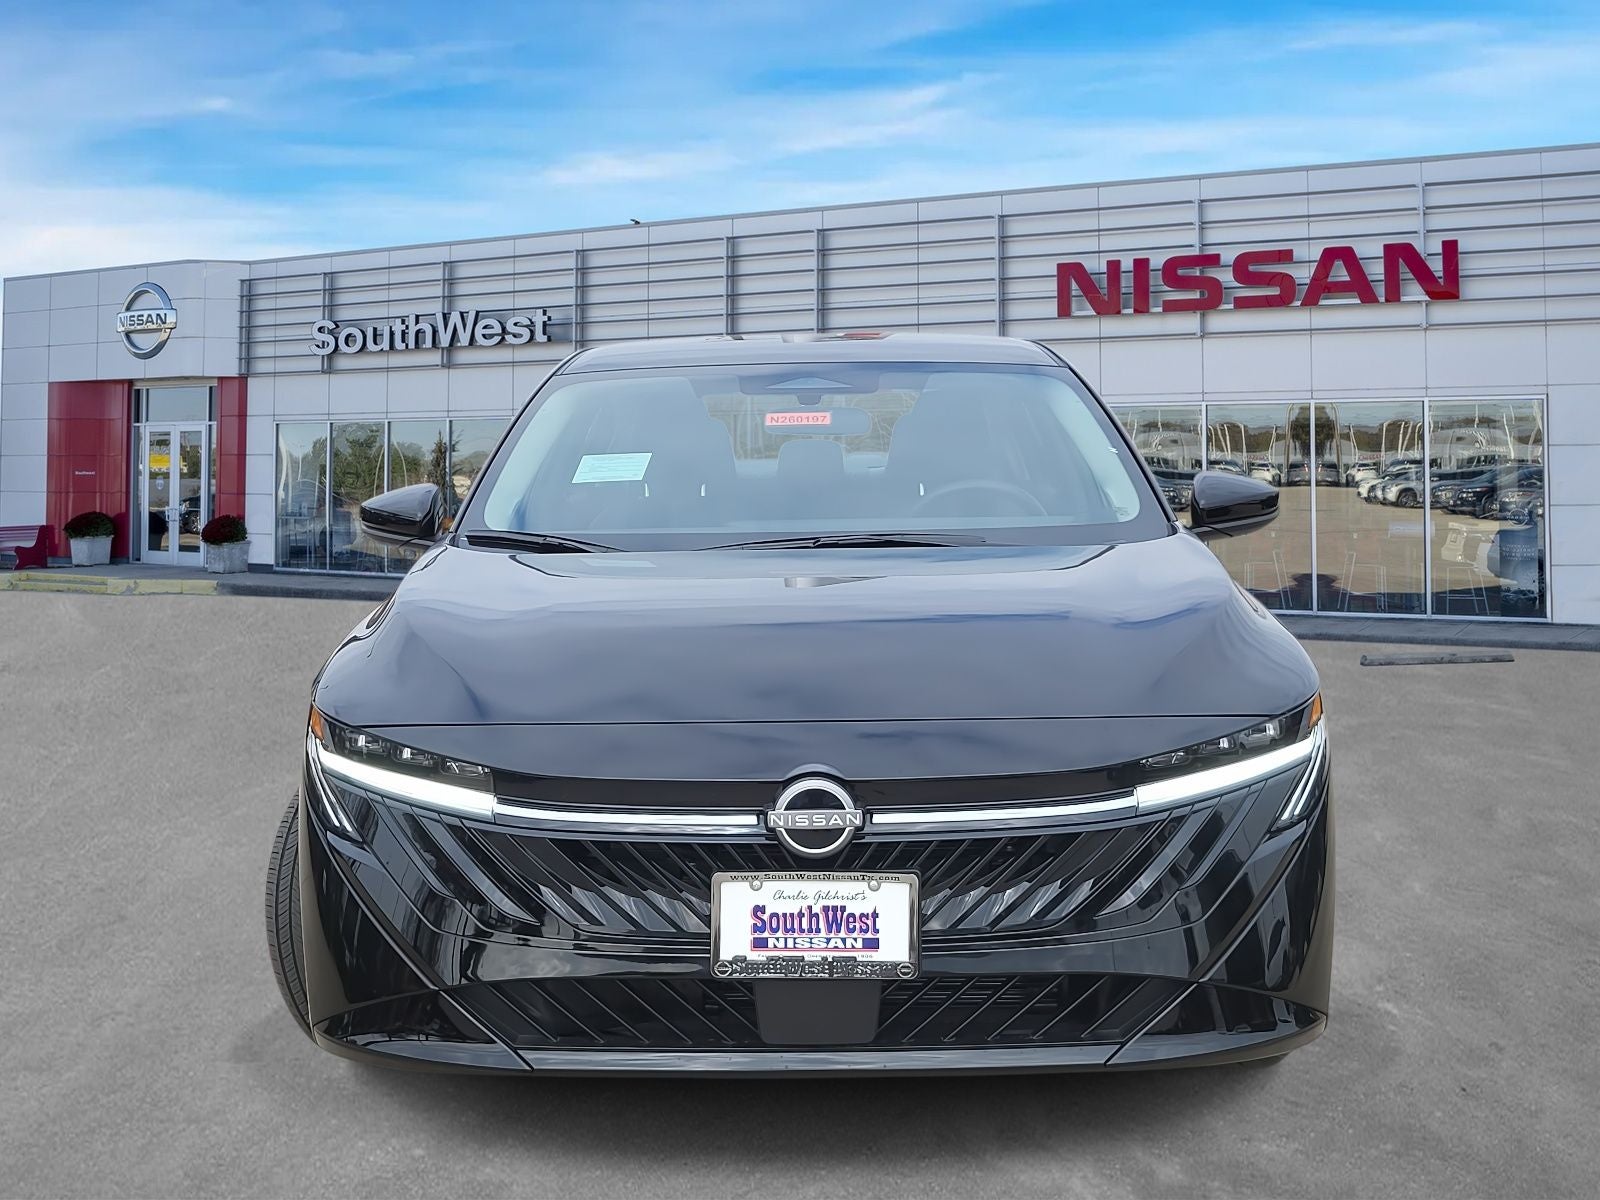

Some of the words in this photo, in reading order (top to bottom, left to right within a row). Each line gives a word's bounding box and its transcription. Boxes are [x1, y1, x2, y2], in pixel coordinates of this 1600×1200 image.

[1057, 239, 1460, 318] NISSAN
[118, 312, 168, 328] NISSAN
[308, 308, 550, 356] SouthWest
[770, 415, 827, 424] N260197
[770, 812, 860, 827] NISSAN
[773, 889, 810, 901] Charlie
[813, 889, 868, 906] Gilchrist's
[751, 904, 880, 936] SouthWest
[767, 937, 863, 949] NISSAN
